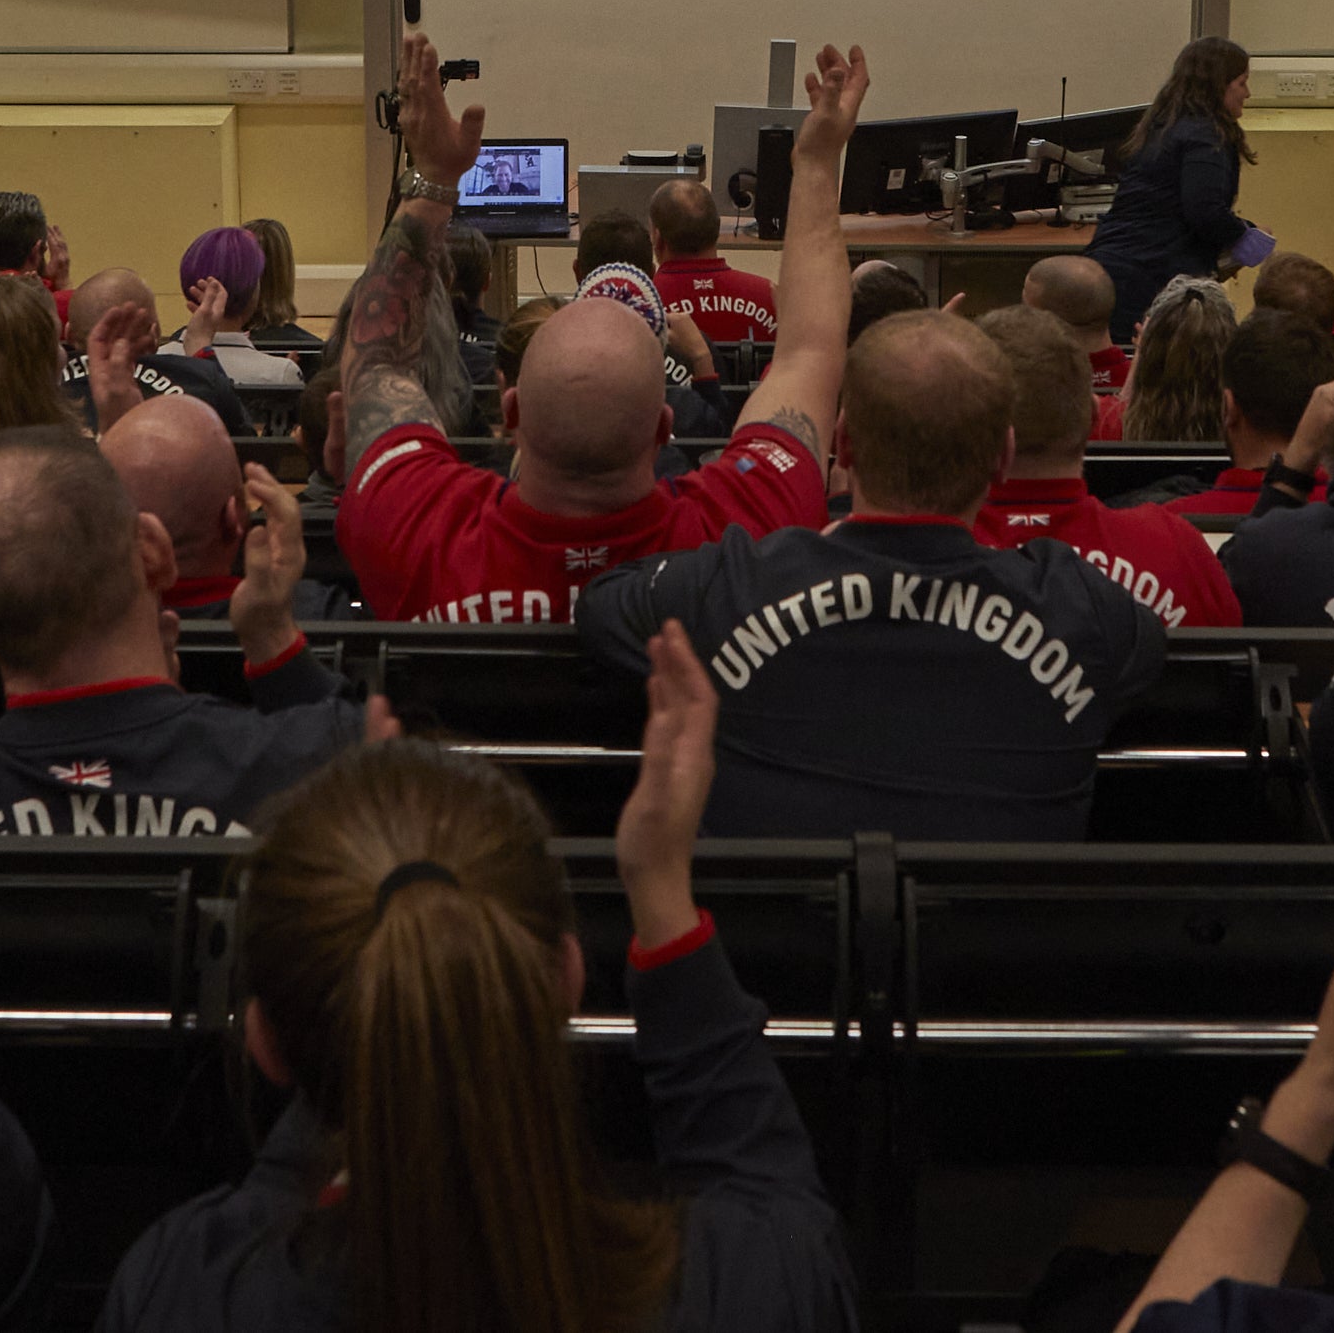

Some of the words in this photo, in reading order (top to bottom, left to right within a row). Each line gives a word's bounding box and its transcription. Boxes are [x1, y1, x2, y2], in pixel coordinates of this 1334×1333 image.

[698, 295, 779, 335] KINGDOM
[711, 572, 873, 691] UNITED
[888, 571, 1096, 724] KINGDOM
